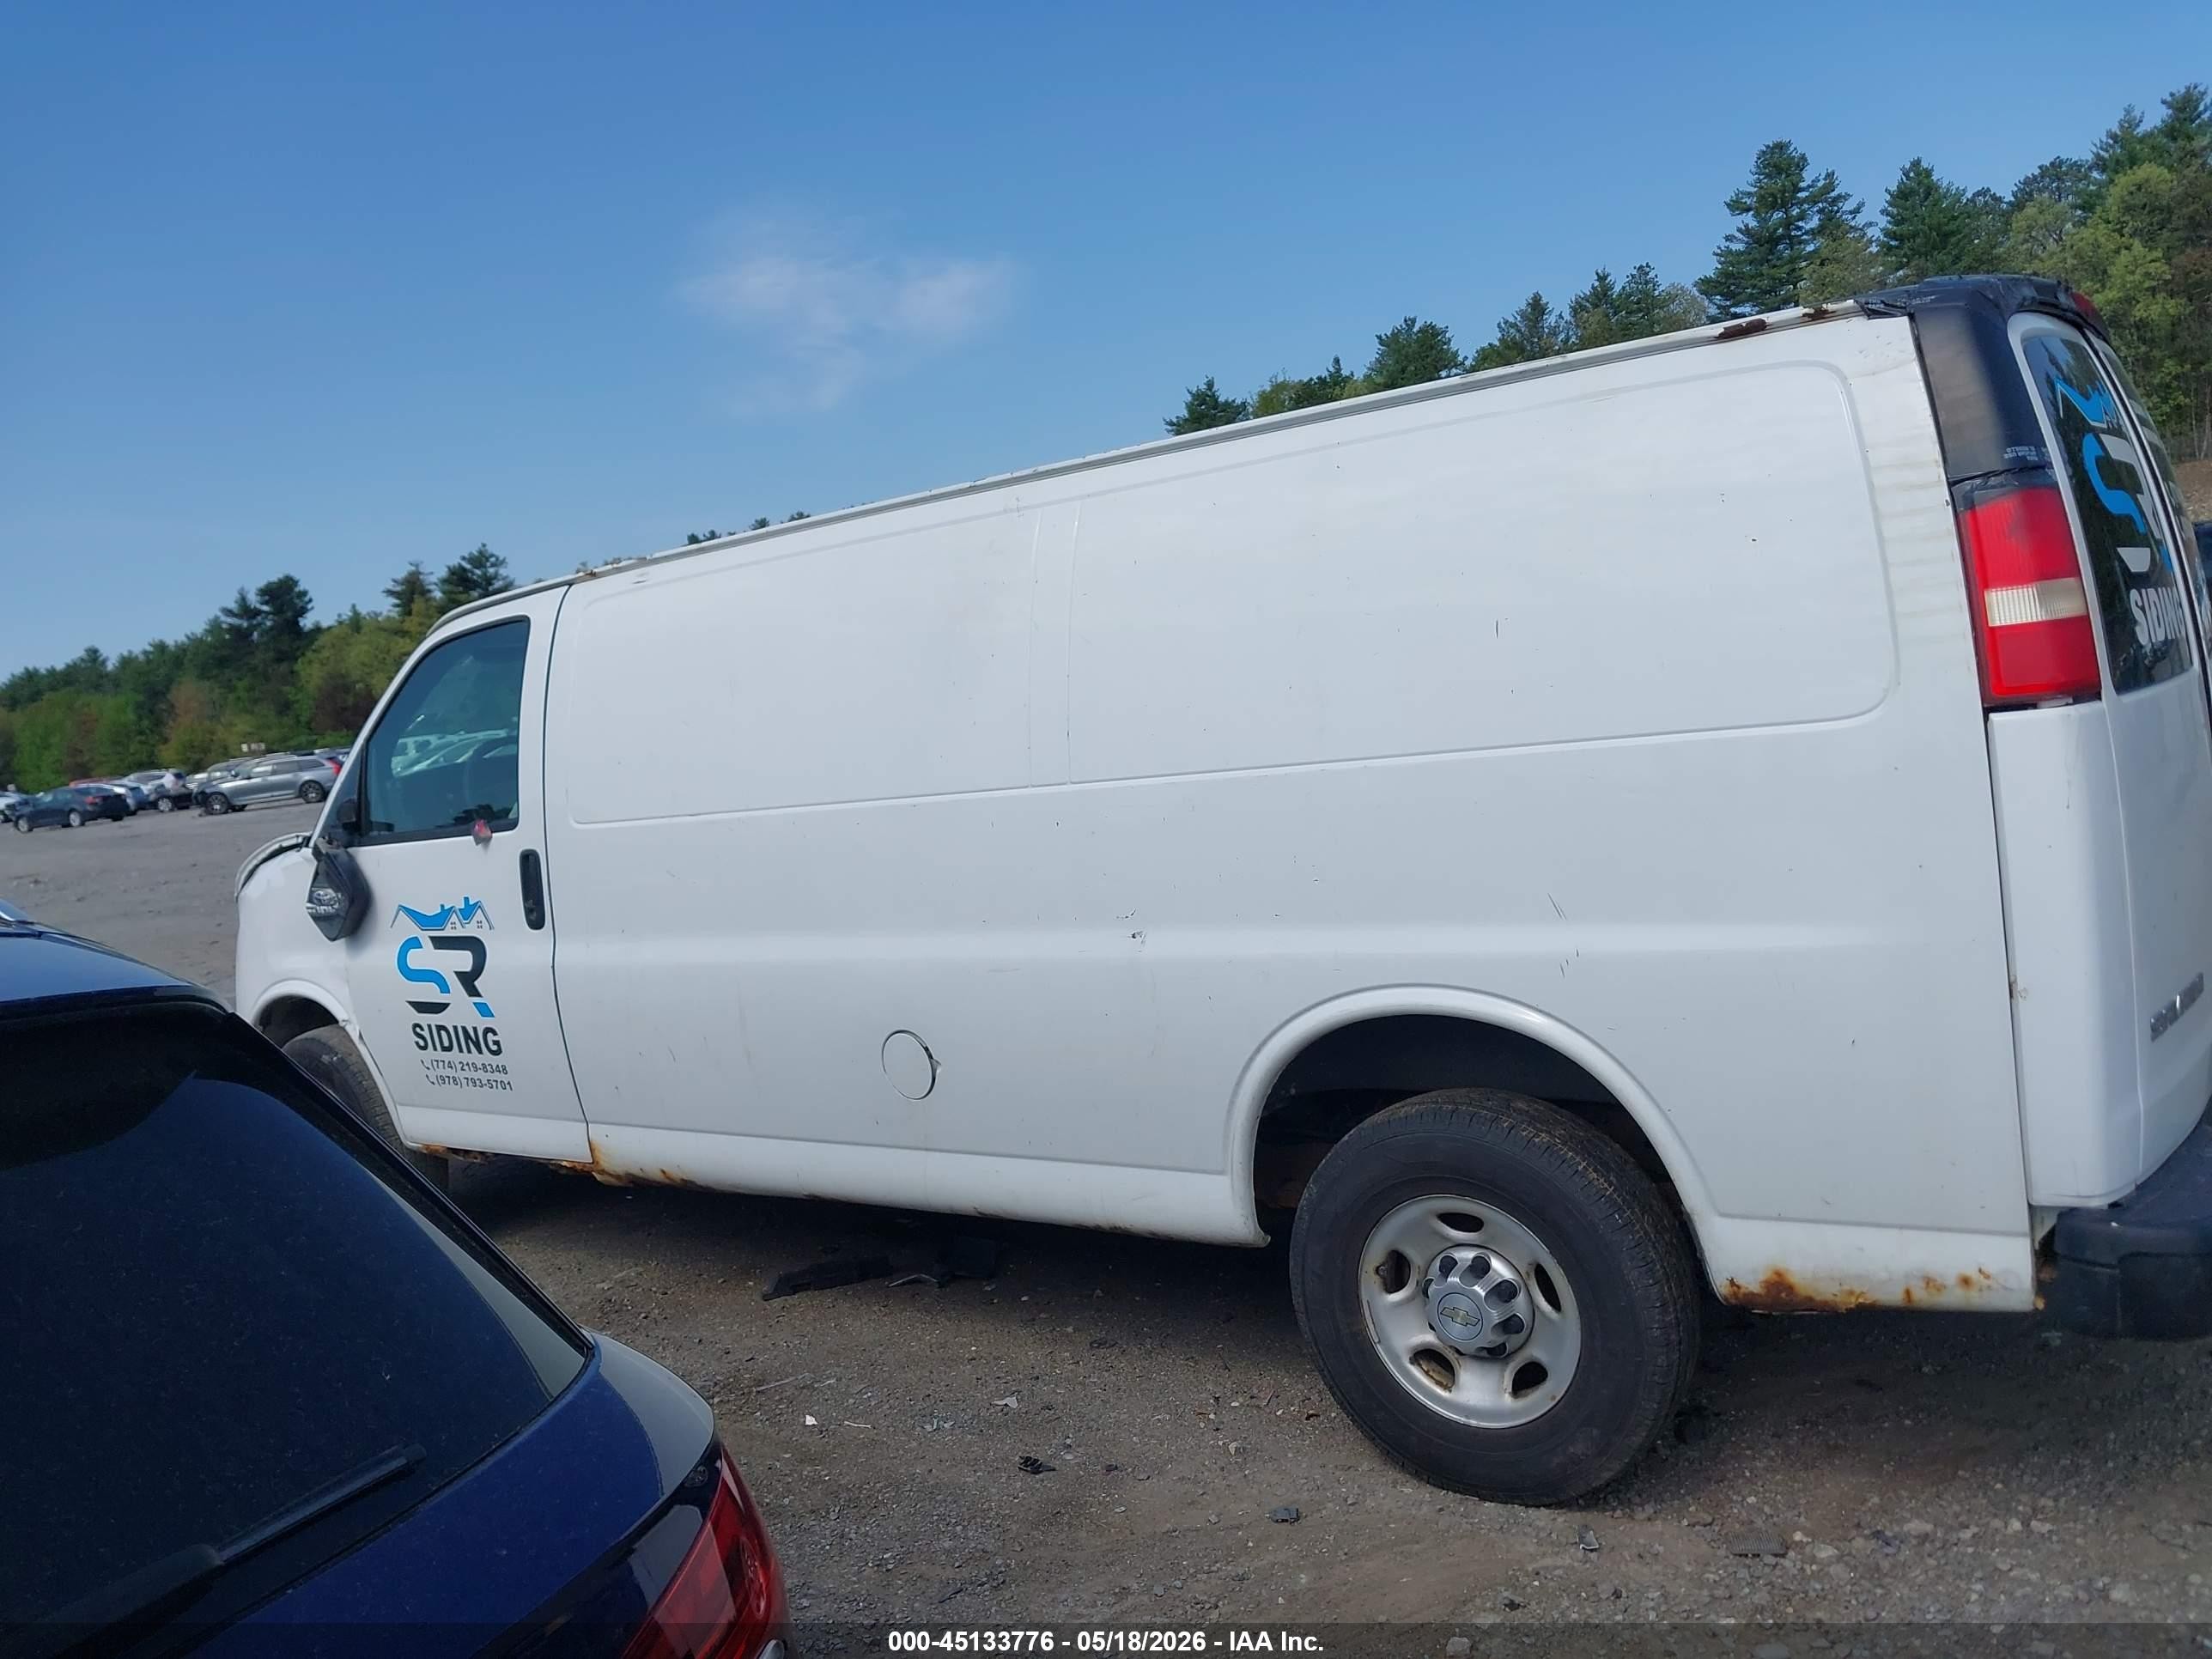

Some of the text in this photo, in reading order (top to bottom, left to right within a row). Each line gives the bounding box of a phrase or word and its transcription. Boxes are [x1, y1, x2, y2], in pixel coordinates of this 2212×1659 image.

[397, 935, 495, 1018] SR
[411, 1023, 503, 1057] SIDING
[430, 1059, 509, 1075] (774) 219-8348
[435, 1075, 514, 1091] (978) 793-5701
